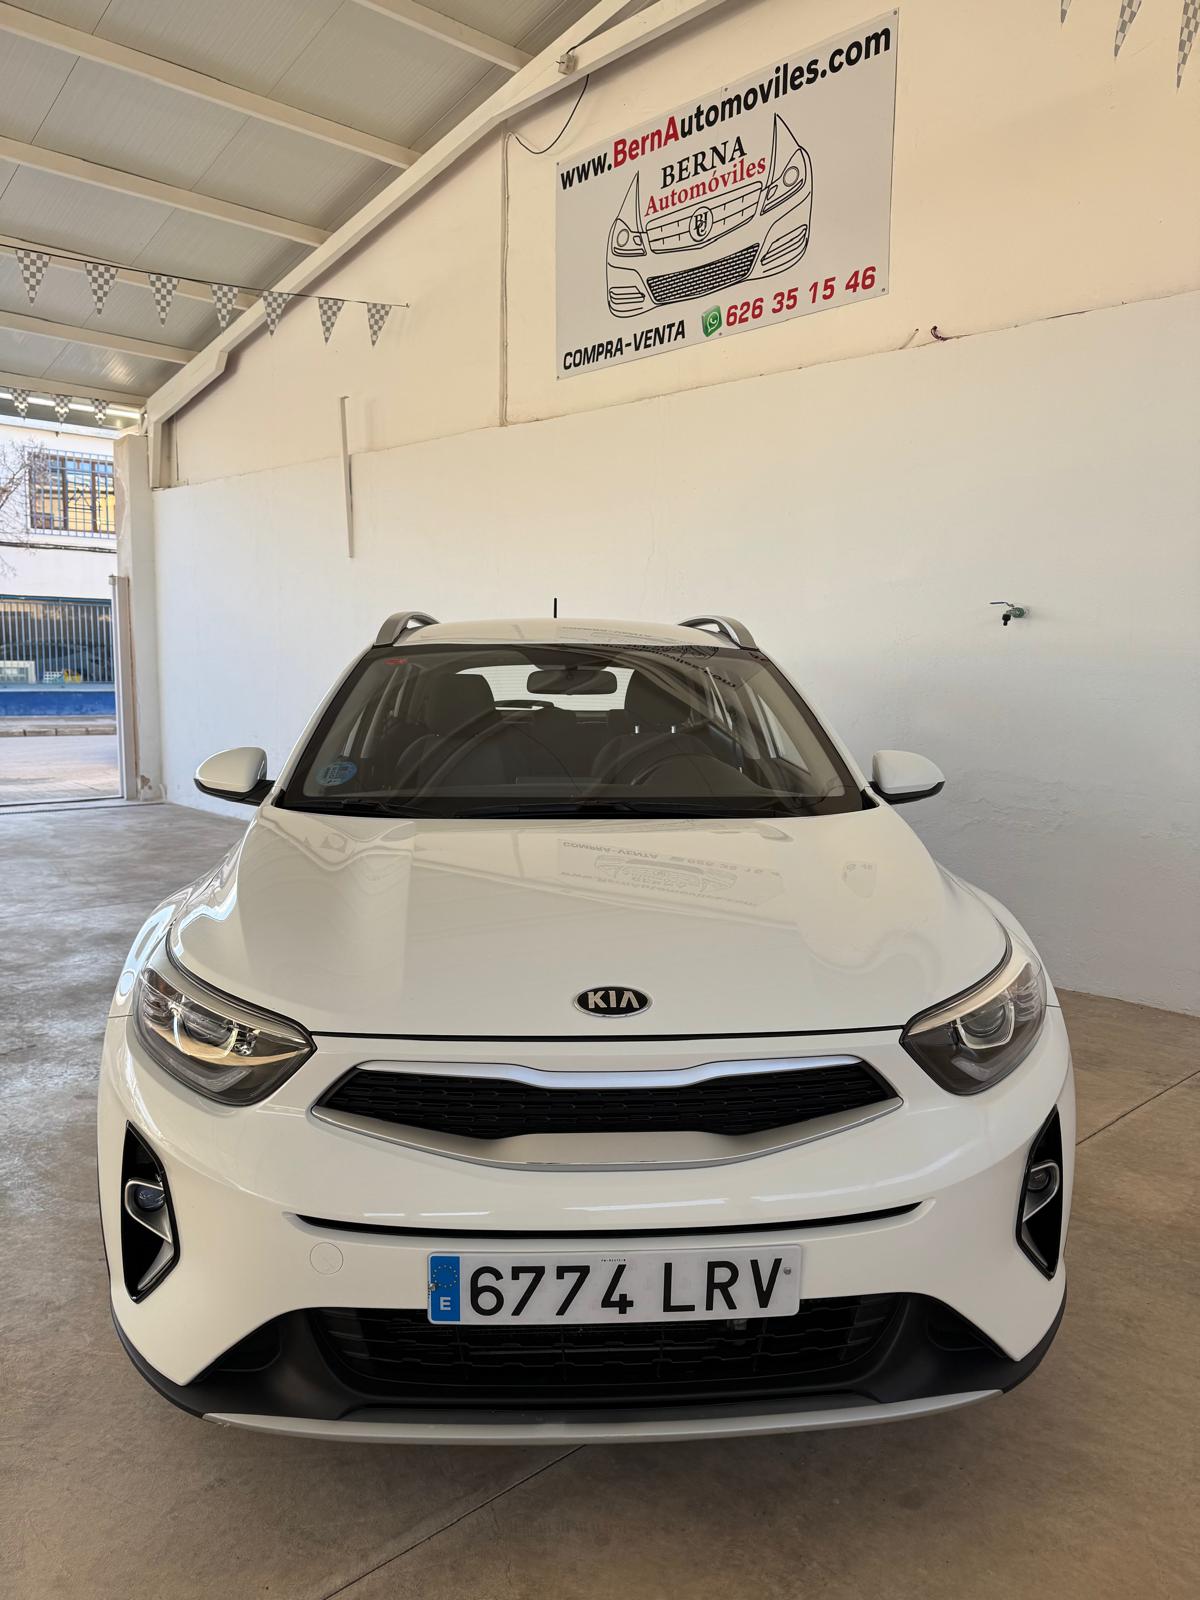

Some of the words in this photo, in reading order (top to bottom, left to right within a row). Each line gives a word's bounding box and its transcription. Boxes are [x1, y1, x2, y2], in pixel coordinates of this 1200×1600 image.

[560, 27, 891, 190] www.BernAutomoviles.com
[644, 157, 766, 217] Automóviles
[660, 136, 747, 189] BERNA
[725, 298, 764, 327] 626
[772, 287, 799, 314] 35
[808, 277, 836, 304] 15
[845, 266, 877, 291] 46
[563, 320, 686, 370] COMPRA-VENTA
[586, 990, 640, 1009] KIA
[439, 1296, 452, 1311] E
[470, 1265, 634, 1316] 6774
[662, 1257, 782, 1313] LRV
